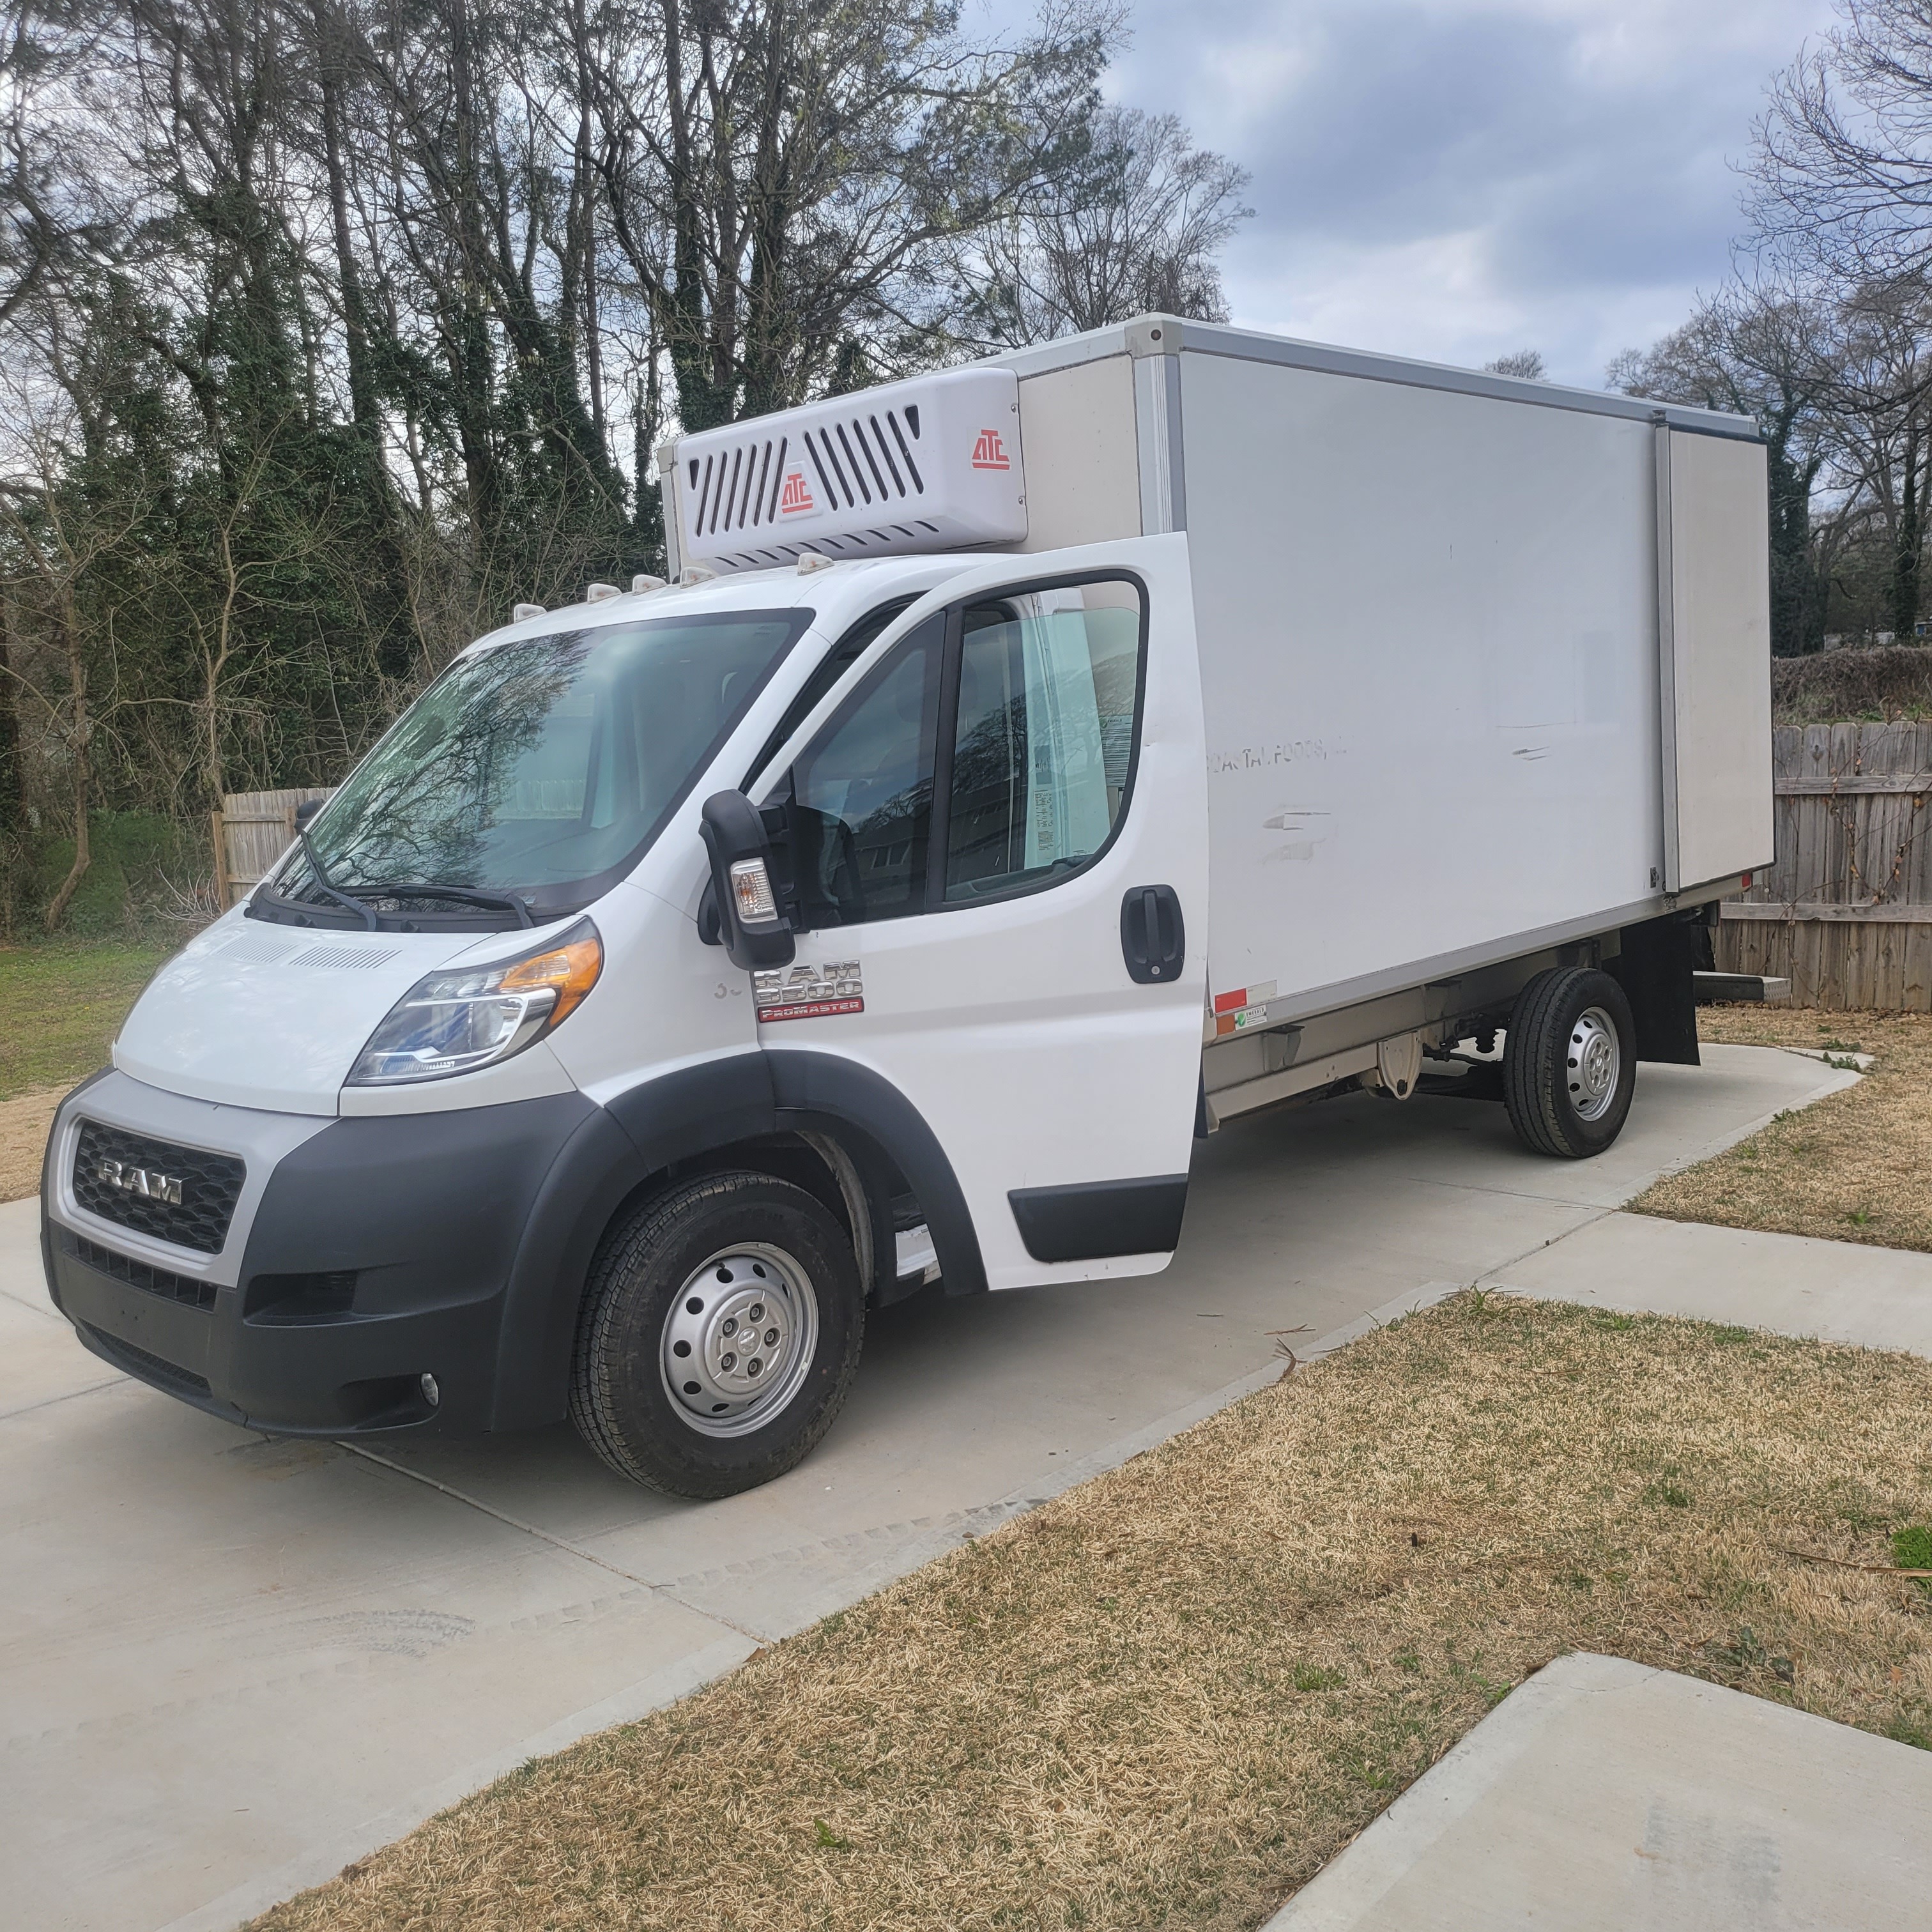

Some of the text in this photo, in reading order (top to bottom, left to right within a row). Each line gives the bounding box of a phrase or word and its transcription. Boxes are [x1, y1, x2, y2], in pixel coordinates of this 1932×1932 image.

[972, 429, 1009, 461] ATC
[781, 473, 813, 506] ATC
[754, 960, 861, 987] RAM
[756, 978, 863, 1004] 3500
[1246, 1008, 1264, 1016] EMERALD
[98, 1157, 182, 1204] RAM
